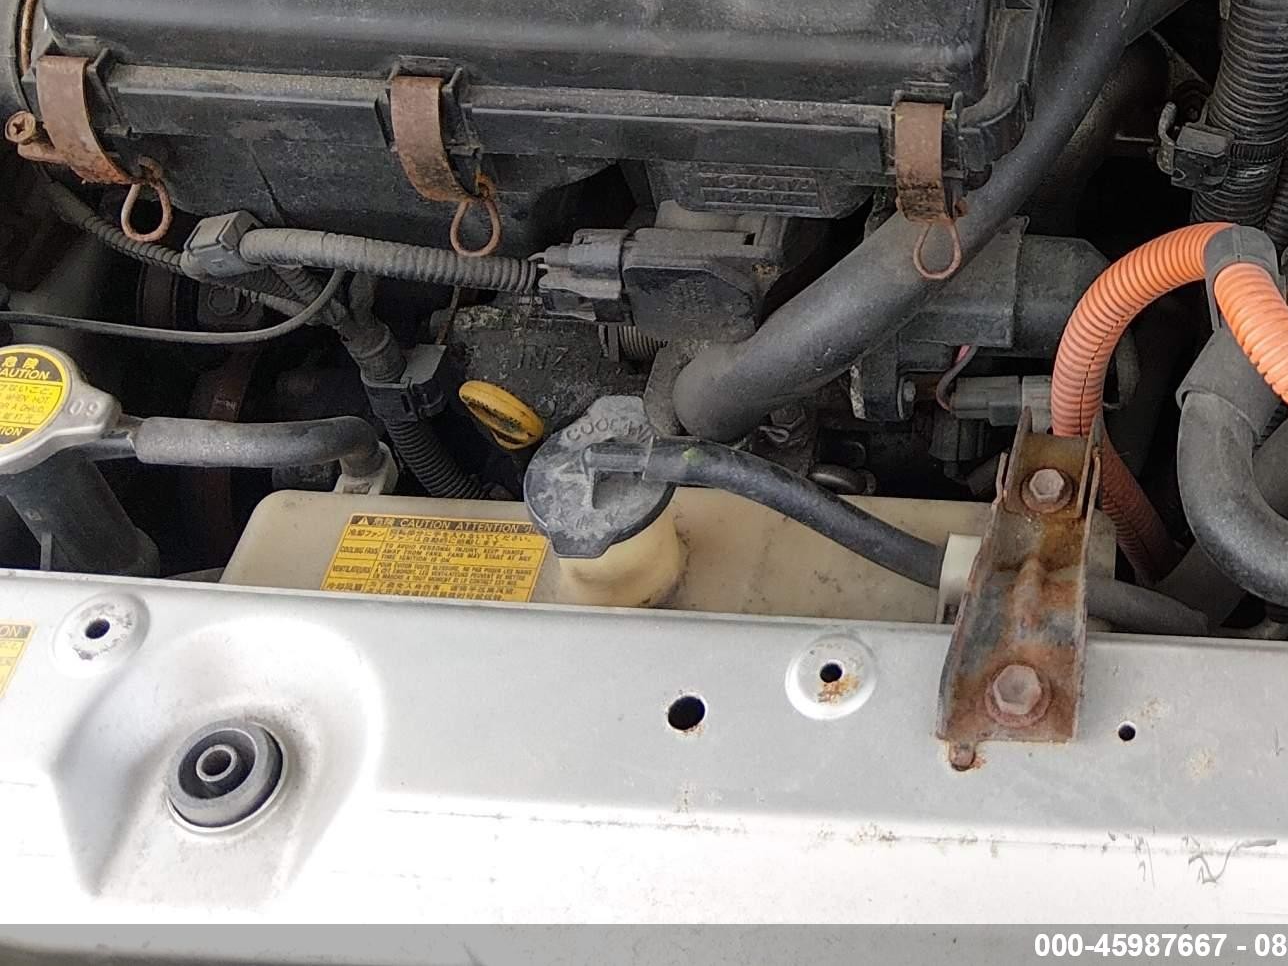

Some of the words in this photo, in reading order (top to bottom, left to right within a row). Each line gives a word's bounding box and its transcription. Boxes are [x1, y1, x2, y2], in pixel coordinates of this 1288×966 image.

[0, 368, 50, 380] AUTION
[400, 519, 451, 530] CAUTION
[455, 522, 519, 534] ATTENTION
